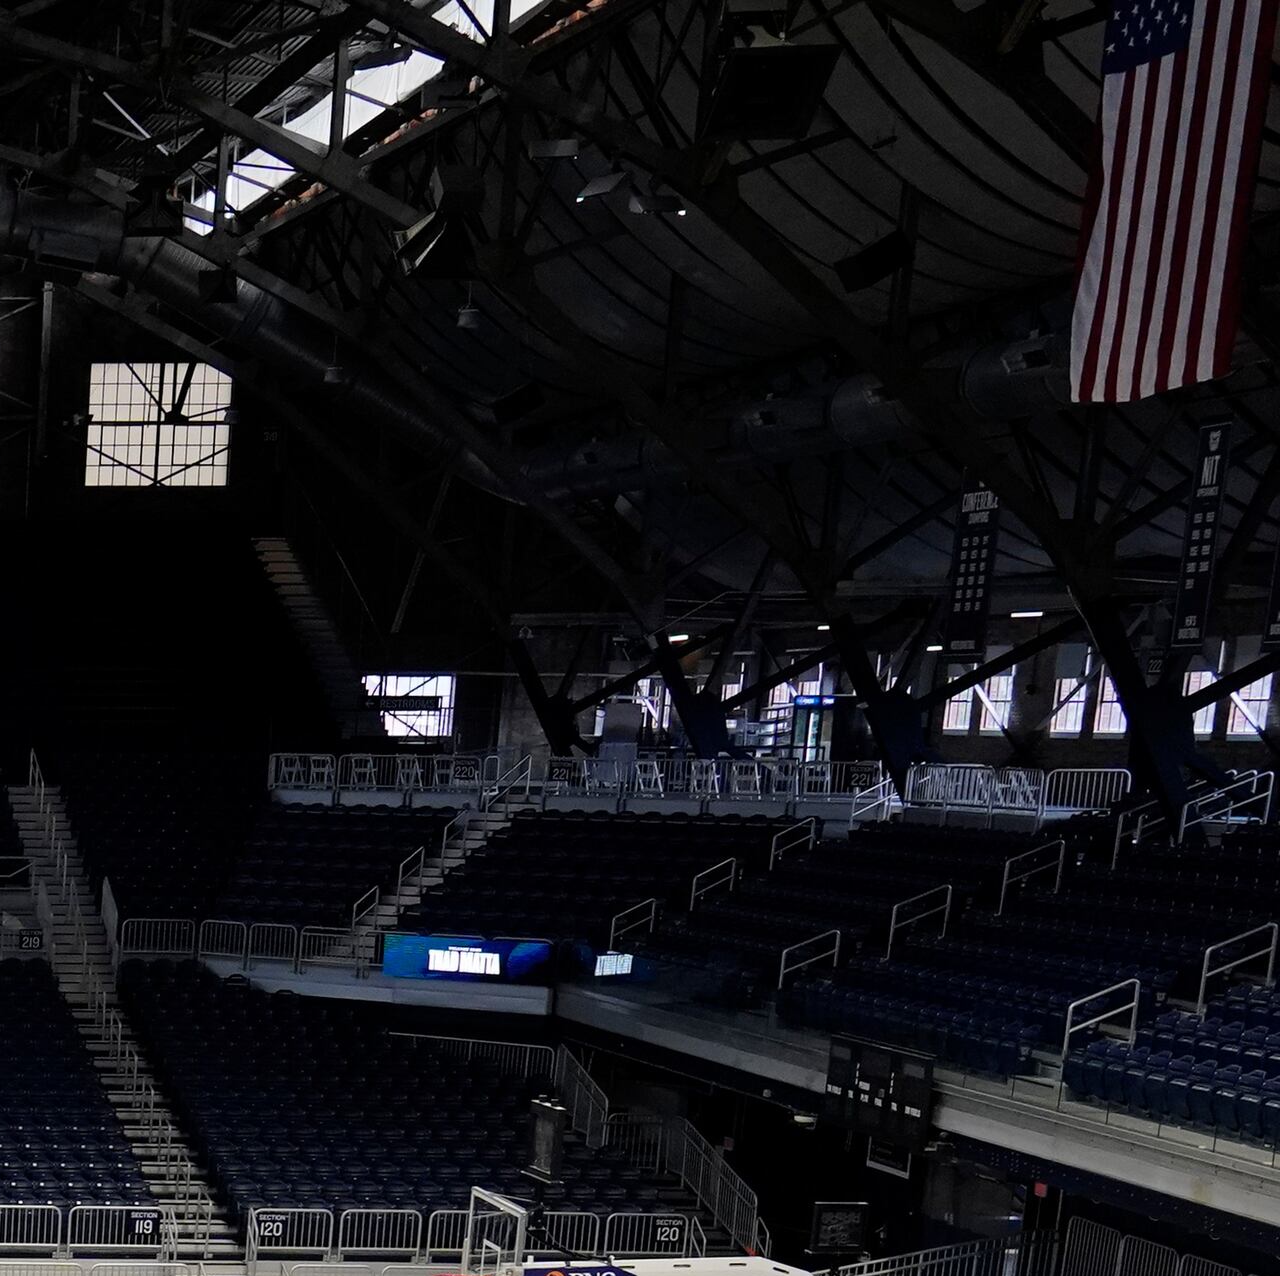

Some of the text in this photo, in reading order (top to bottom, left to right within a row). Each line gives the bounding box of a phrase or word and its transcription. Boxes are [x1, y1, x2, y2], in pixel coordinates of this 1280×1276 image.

[1201, 455, 1221, 487] NIT
[379, 700, 437, 710] RESTROOMS
[455, 766, 475, 778] 220
[553, 769, 569, 780] 221
[851, 774, 870, 785] 221
[21, 936, 40, 948] 219
[131, 1211, 159, 1219] SECTION
[135, 1219, 153, 1234] 119
[261, 1221, 283, 1236] 120
[656, 1227, 679, 1241] 120
